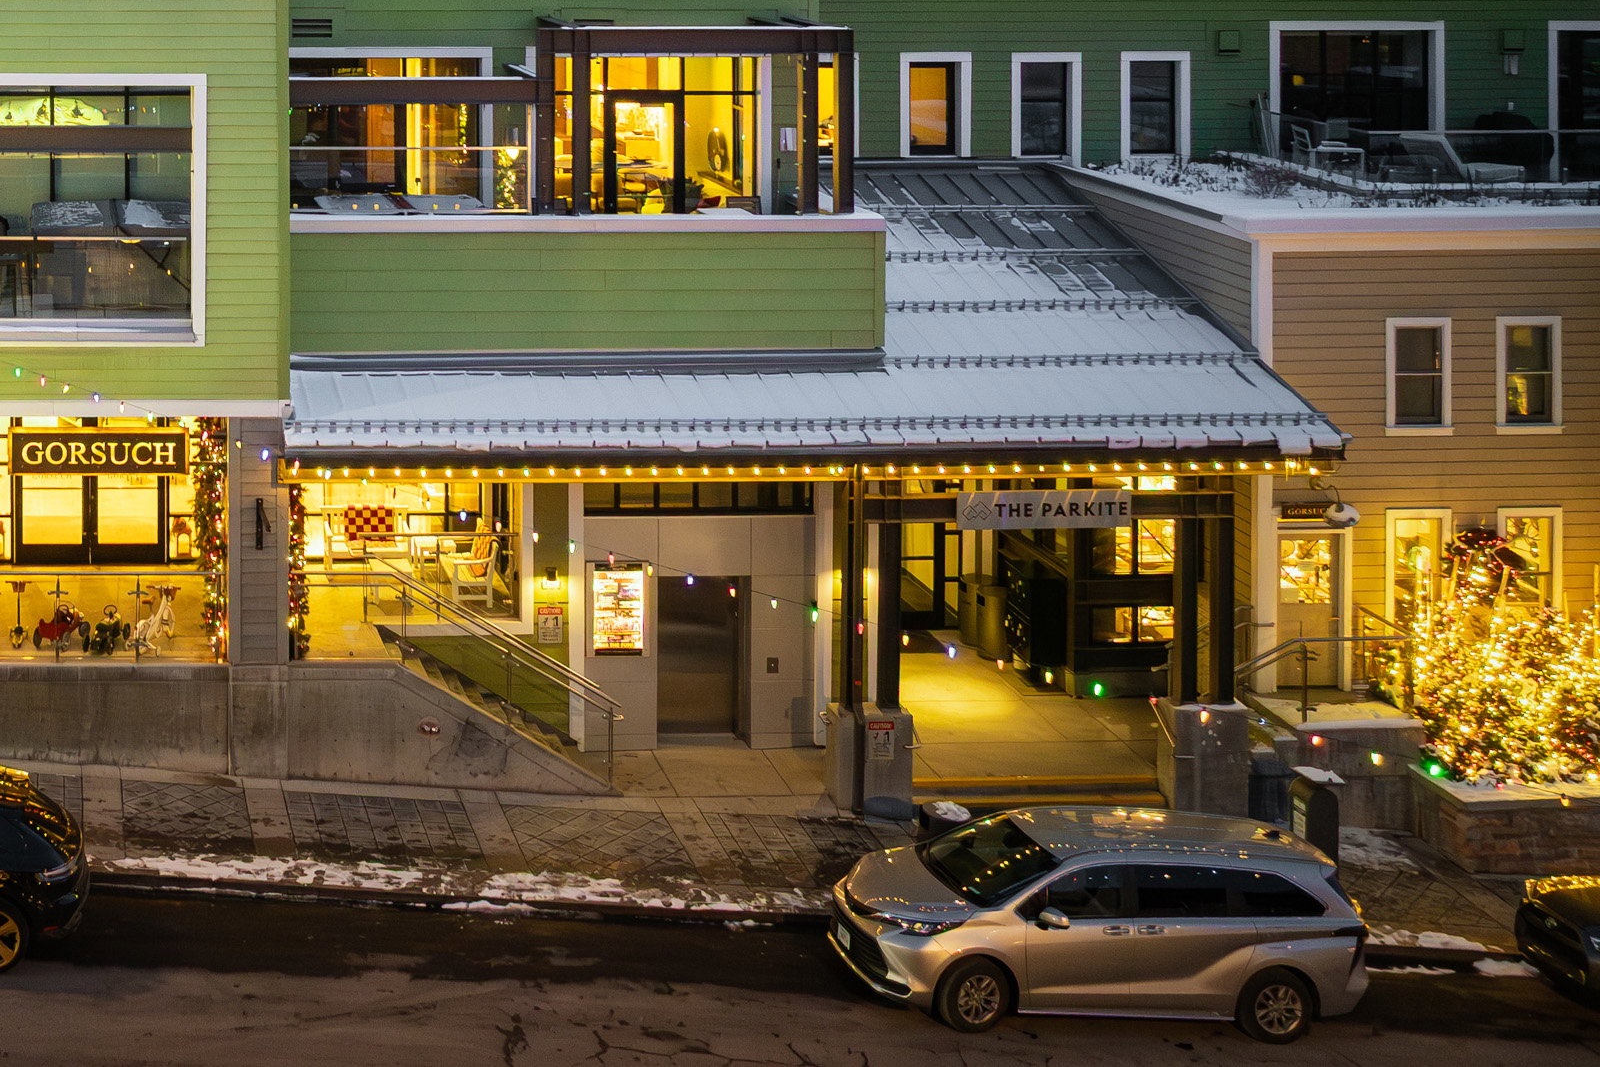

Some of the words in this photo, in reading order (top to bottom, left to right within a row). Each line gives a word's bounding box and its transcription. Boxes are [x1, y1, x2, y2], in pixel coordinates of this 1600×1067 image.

[21, 441, 177, 466] GORSUCH
[994, 503, 1033, 518] THE
[1041, 501, 1128, 518] PARKITE
[1287, 507, 1326, 516] GORSUC
